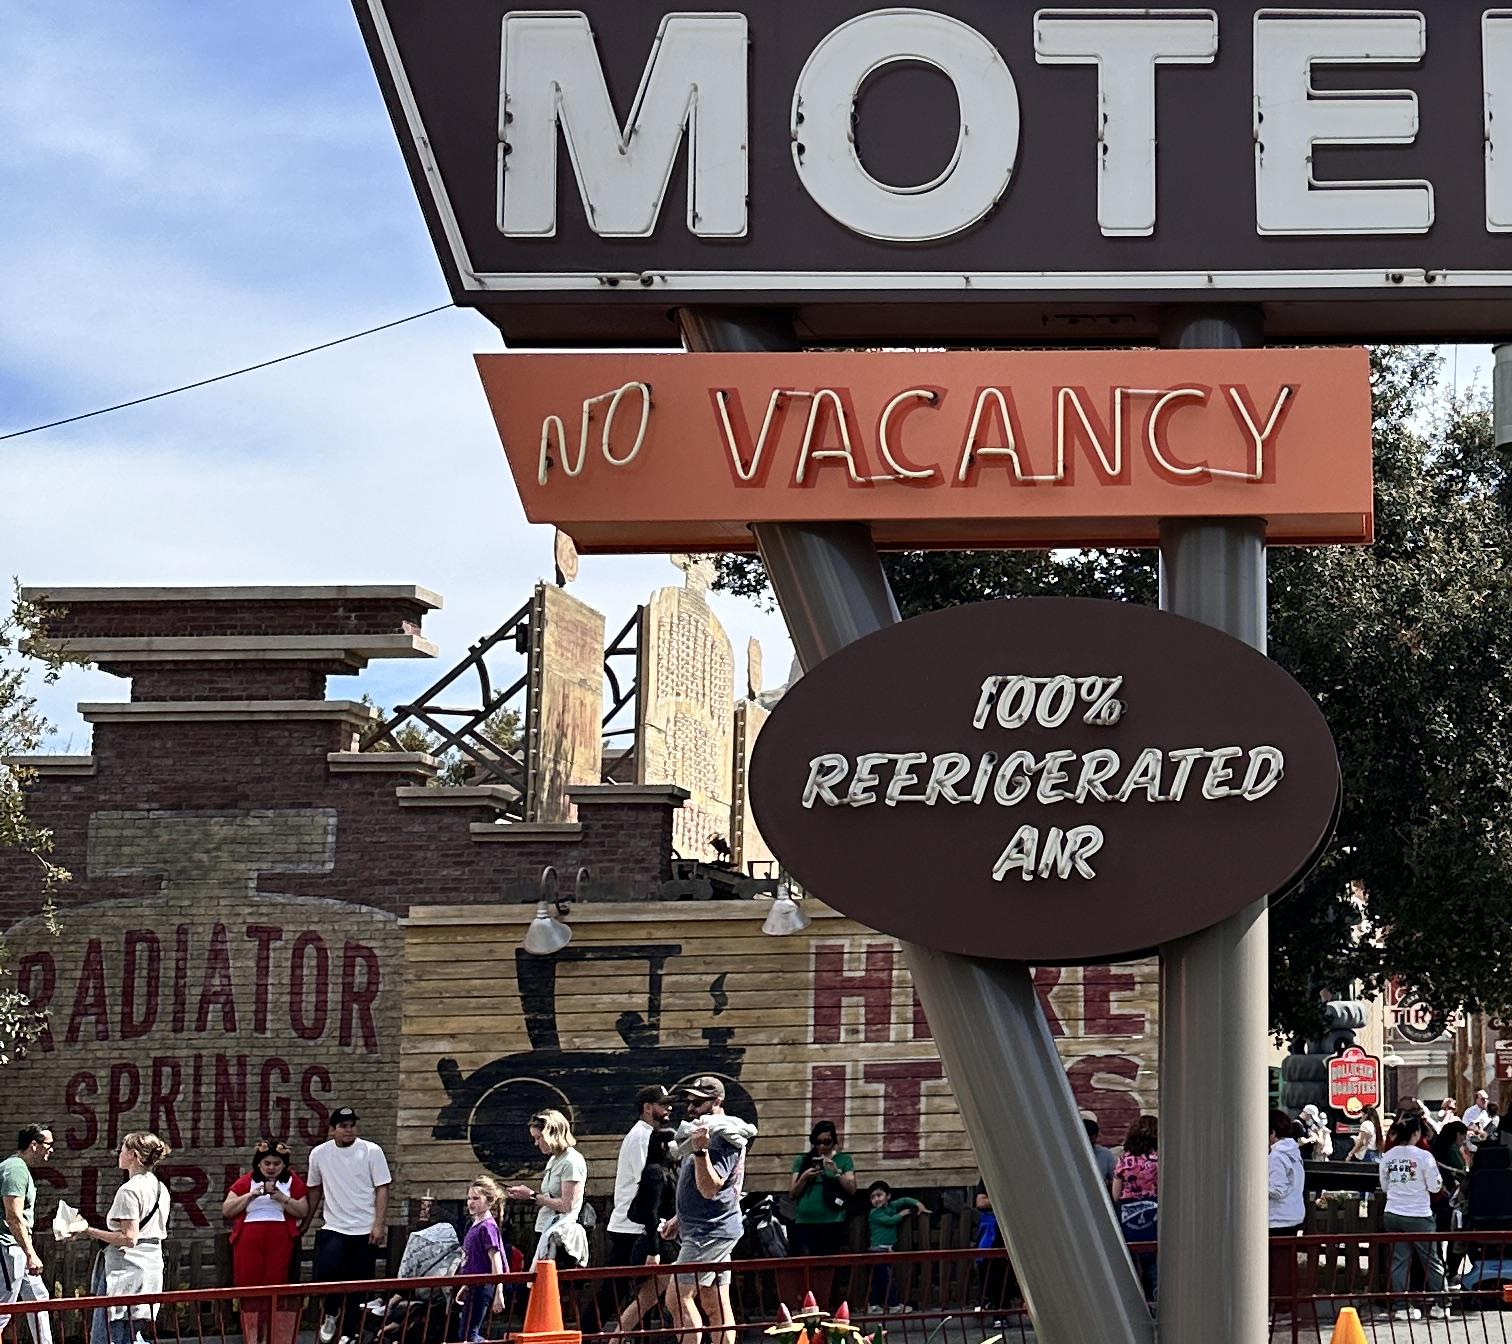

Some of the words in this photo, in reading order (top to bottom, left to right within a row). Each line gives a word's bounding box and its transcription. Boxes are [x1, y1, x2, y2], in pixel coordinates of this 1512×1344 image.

[536, 381, 652, 486] NO
[707, 383, 1302, 490] VACANCY
[973, 674, 1128, 730] 100%
[802, 745, 1286, 809] REFRIGERATED
[992, 824, 1104, 882] AIR
[14, 922, 382, 1056] RADIATOR
[65, 1052, 335, 1152] SPRINGS
